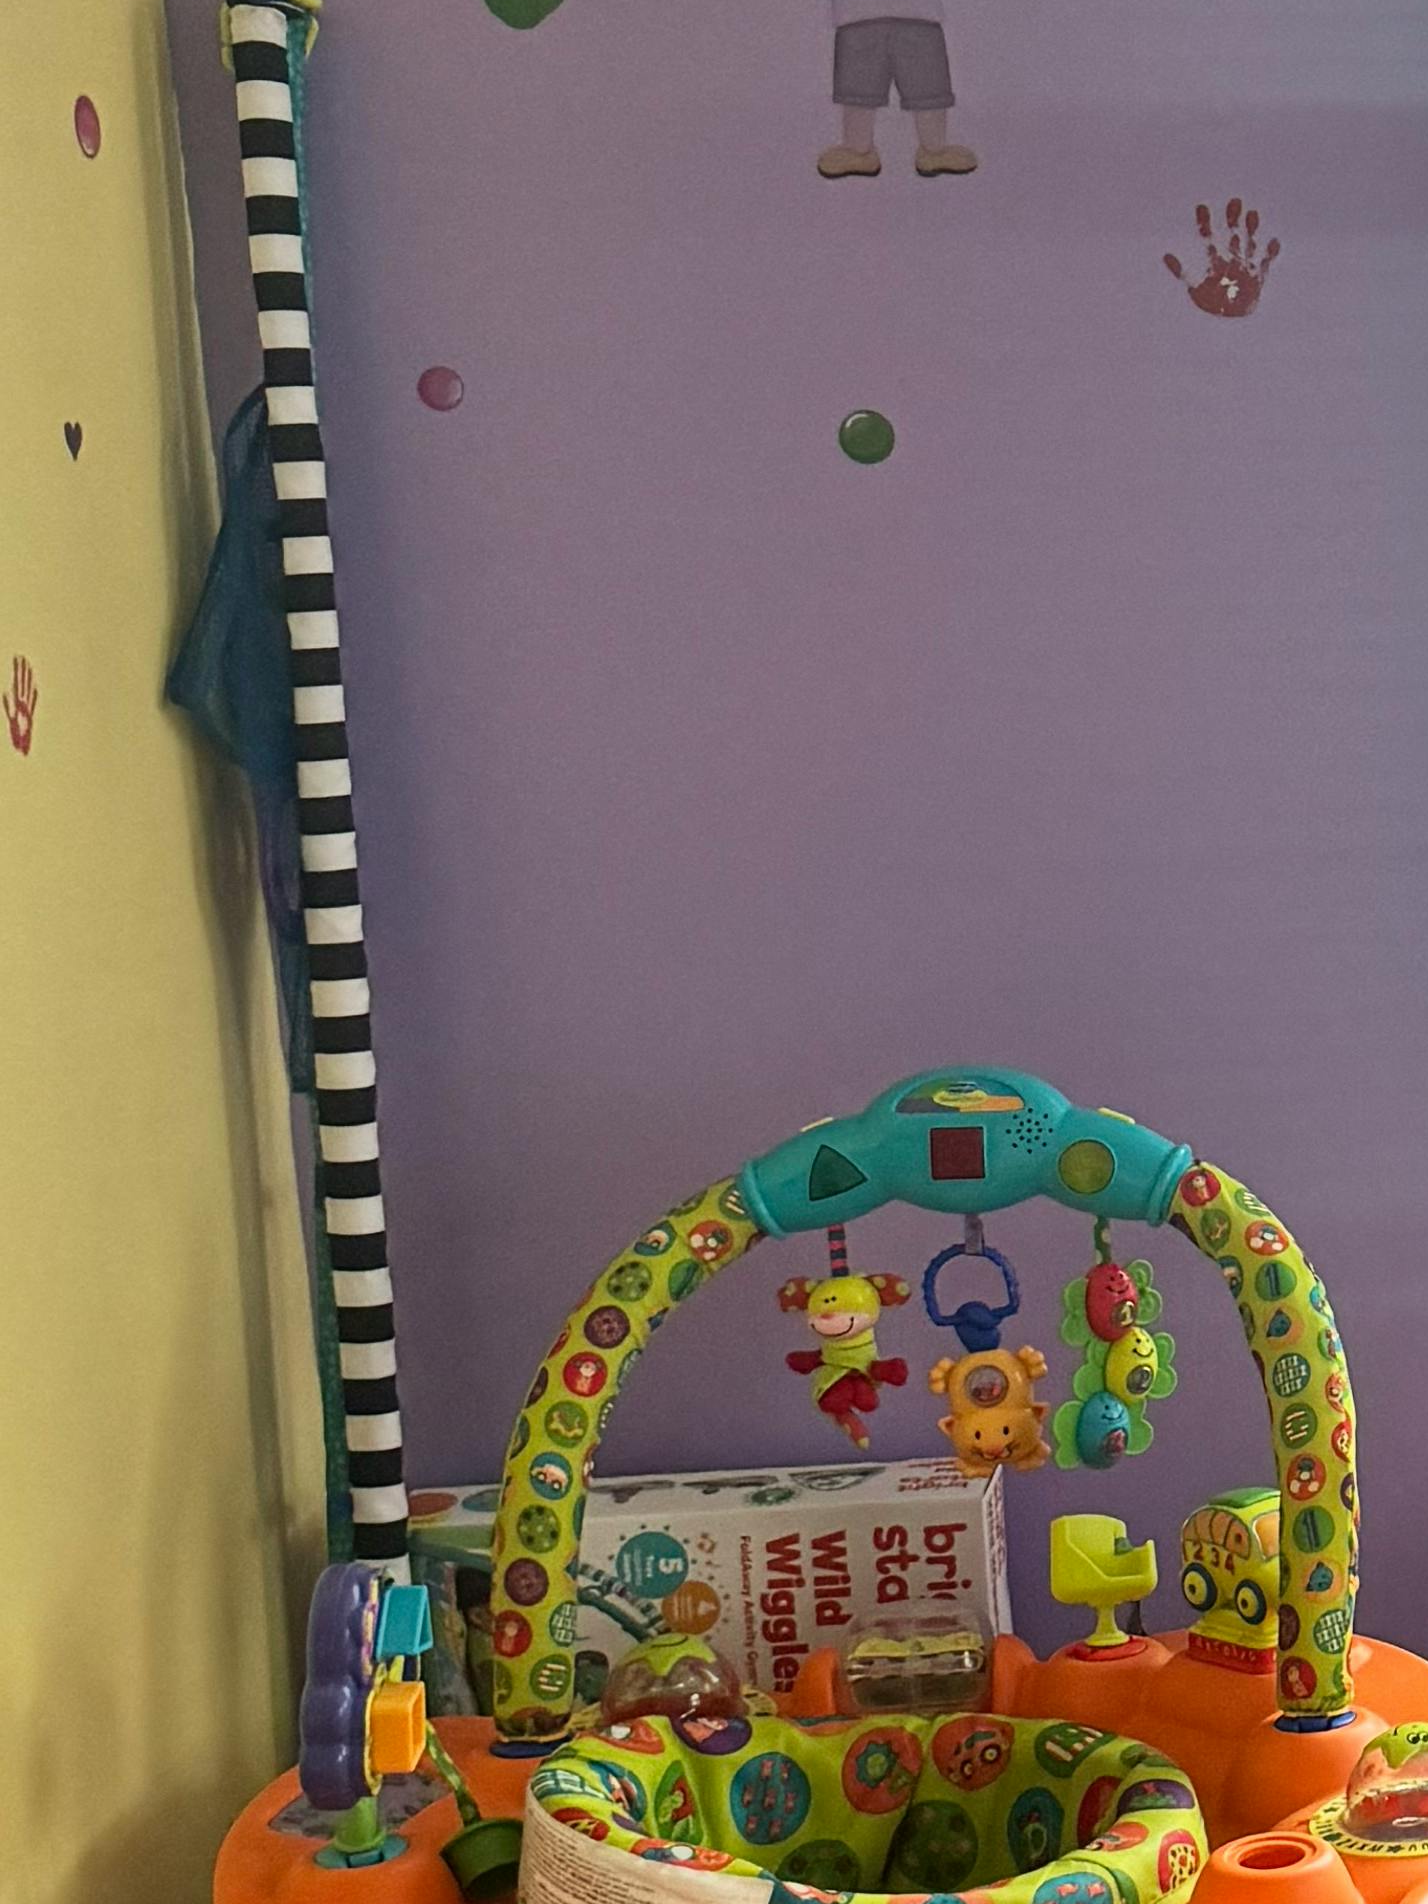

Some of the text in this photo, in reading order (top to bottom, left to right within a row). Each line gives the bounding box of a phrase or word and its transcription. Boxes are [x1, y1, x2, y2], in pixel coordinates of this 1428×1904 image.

[658, 1557, 684, 1575] 5
[811, 1529, 853, 1626] Wild
[923, 1523, 972, 1600] bri
[742, 1599, 756, 1648] Activity
